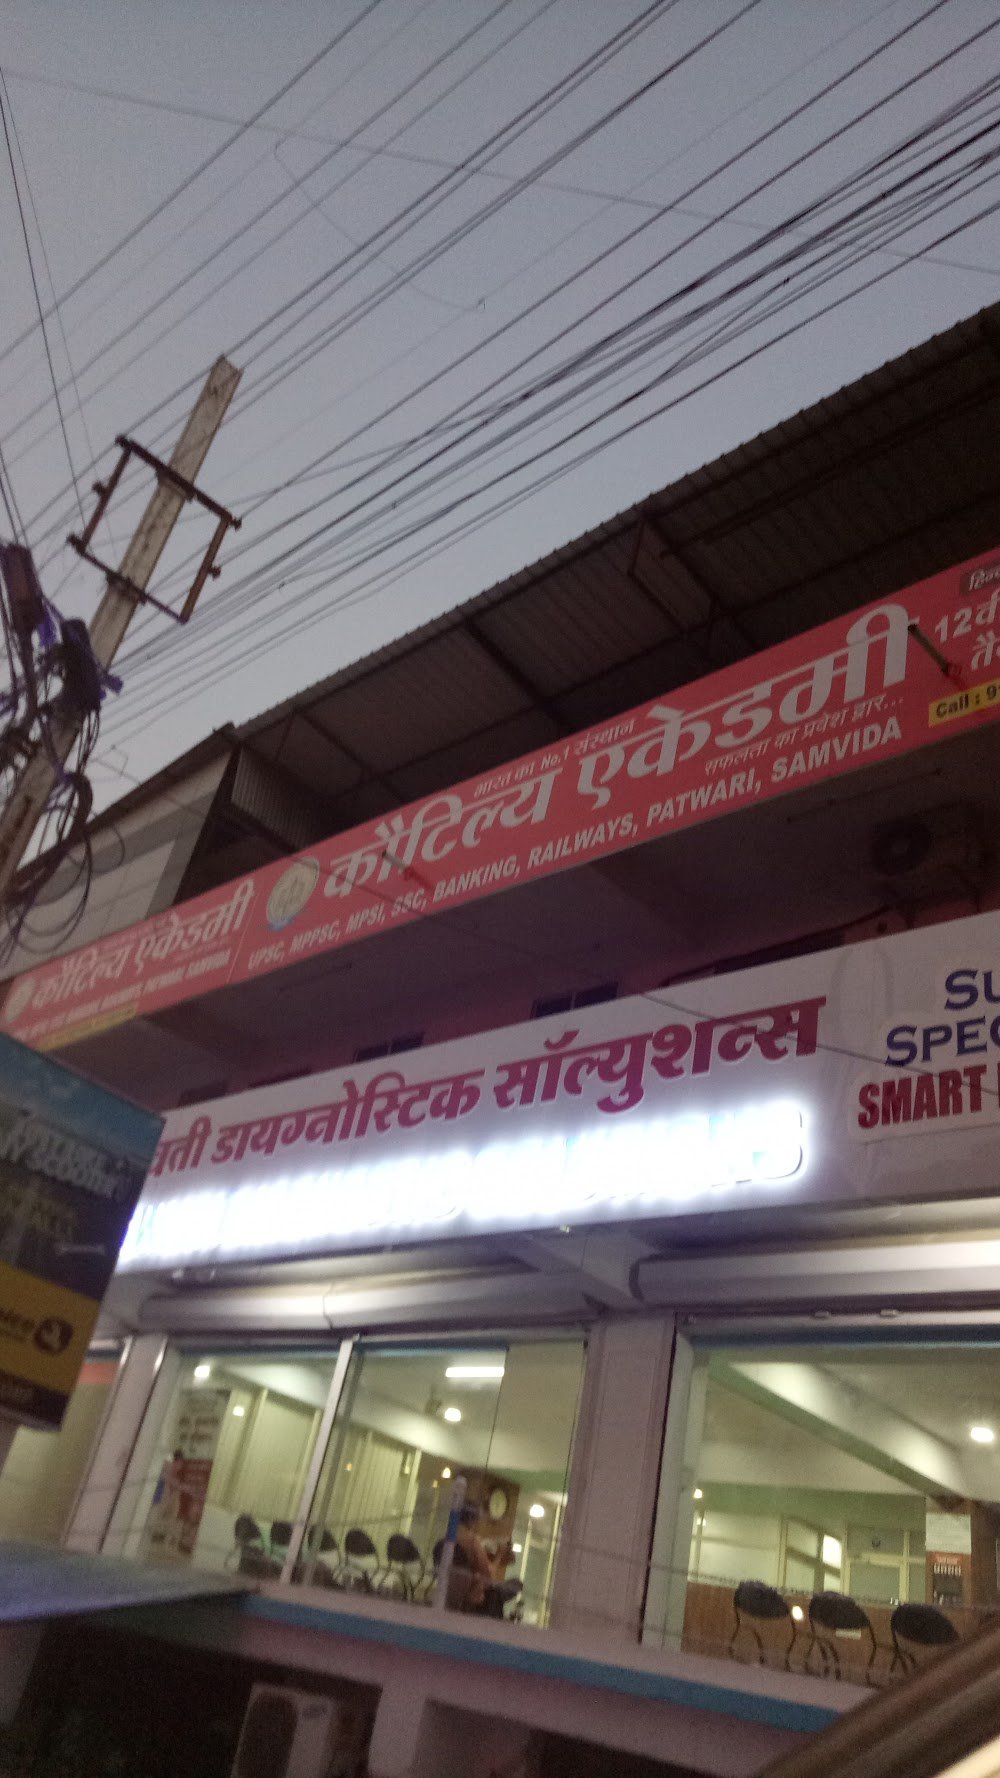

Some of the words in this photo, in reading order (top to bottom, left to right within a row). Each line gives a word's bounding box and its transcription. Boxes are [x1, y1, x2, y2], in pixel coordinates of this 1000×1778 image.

[936, 693, 969, 718] Call
[324, 768, 563, 897] कौटिल्य
[576, 603, 919, 811] एकेडमी
[774, 727, 801, 750] का
[514, 762, 535, 781] का
[432, 856, 520, 903] BANKING,
[527, 813, 638, 869] RAILWAYS,
[646, 768, 761, 827] PATWARI,
[771, 716, 902, 783] SAMVIDA
[210, 1069, 485, 1164] डायग्नोस्टिक
[493, 996, 827, 1114] सॉल्युशन्स
[858, 1064, 987, 1129] SMART
